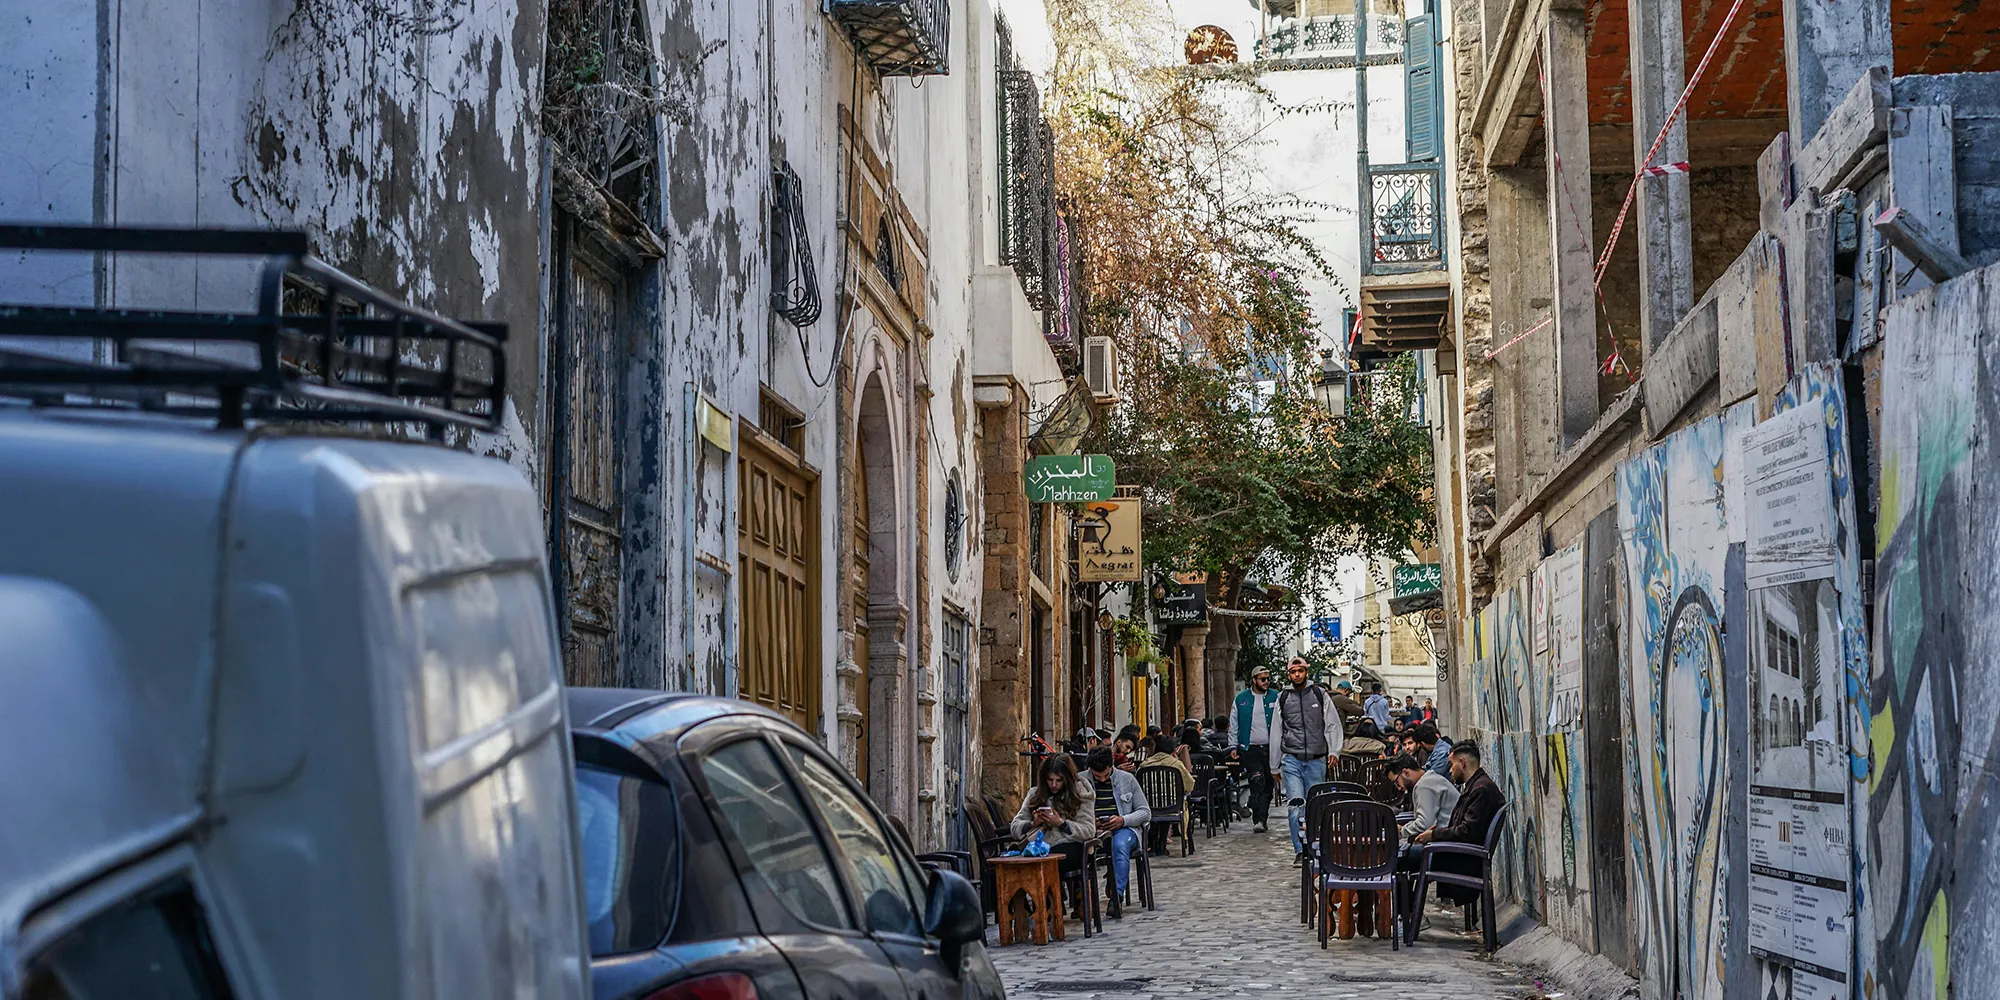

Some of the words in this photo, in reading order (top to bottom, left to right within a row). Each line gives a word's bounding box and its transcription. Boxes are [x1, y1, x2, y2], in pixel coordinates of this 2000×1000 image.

[1499, 320, 1514, 335] 60
[1028, 456, 1098, 489] المخزن
[1039, 485, 1098, 501] Makhzen
